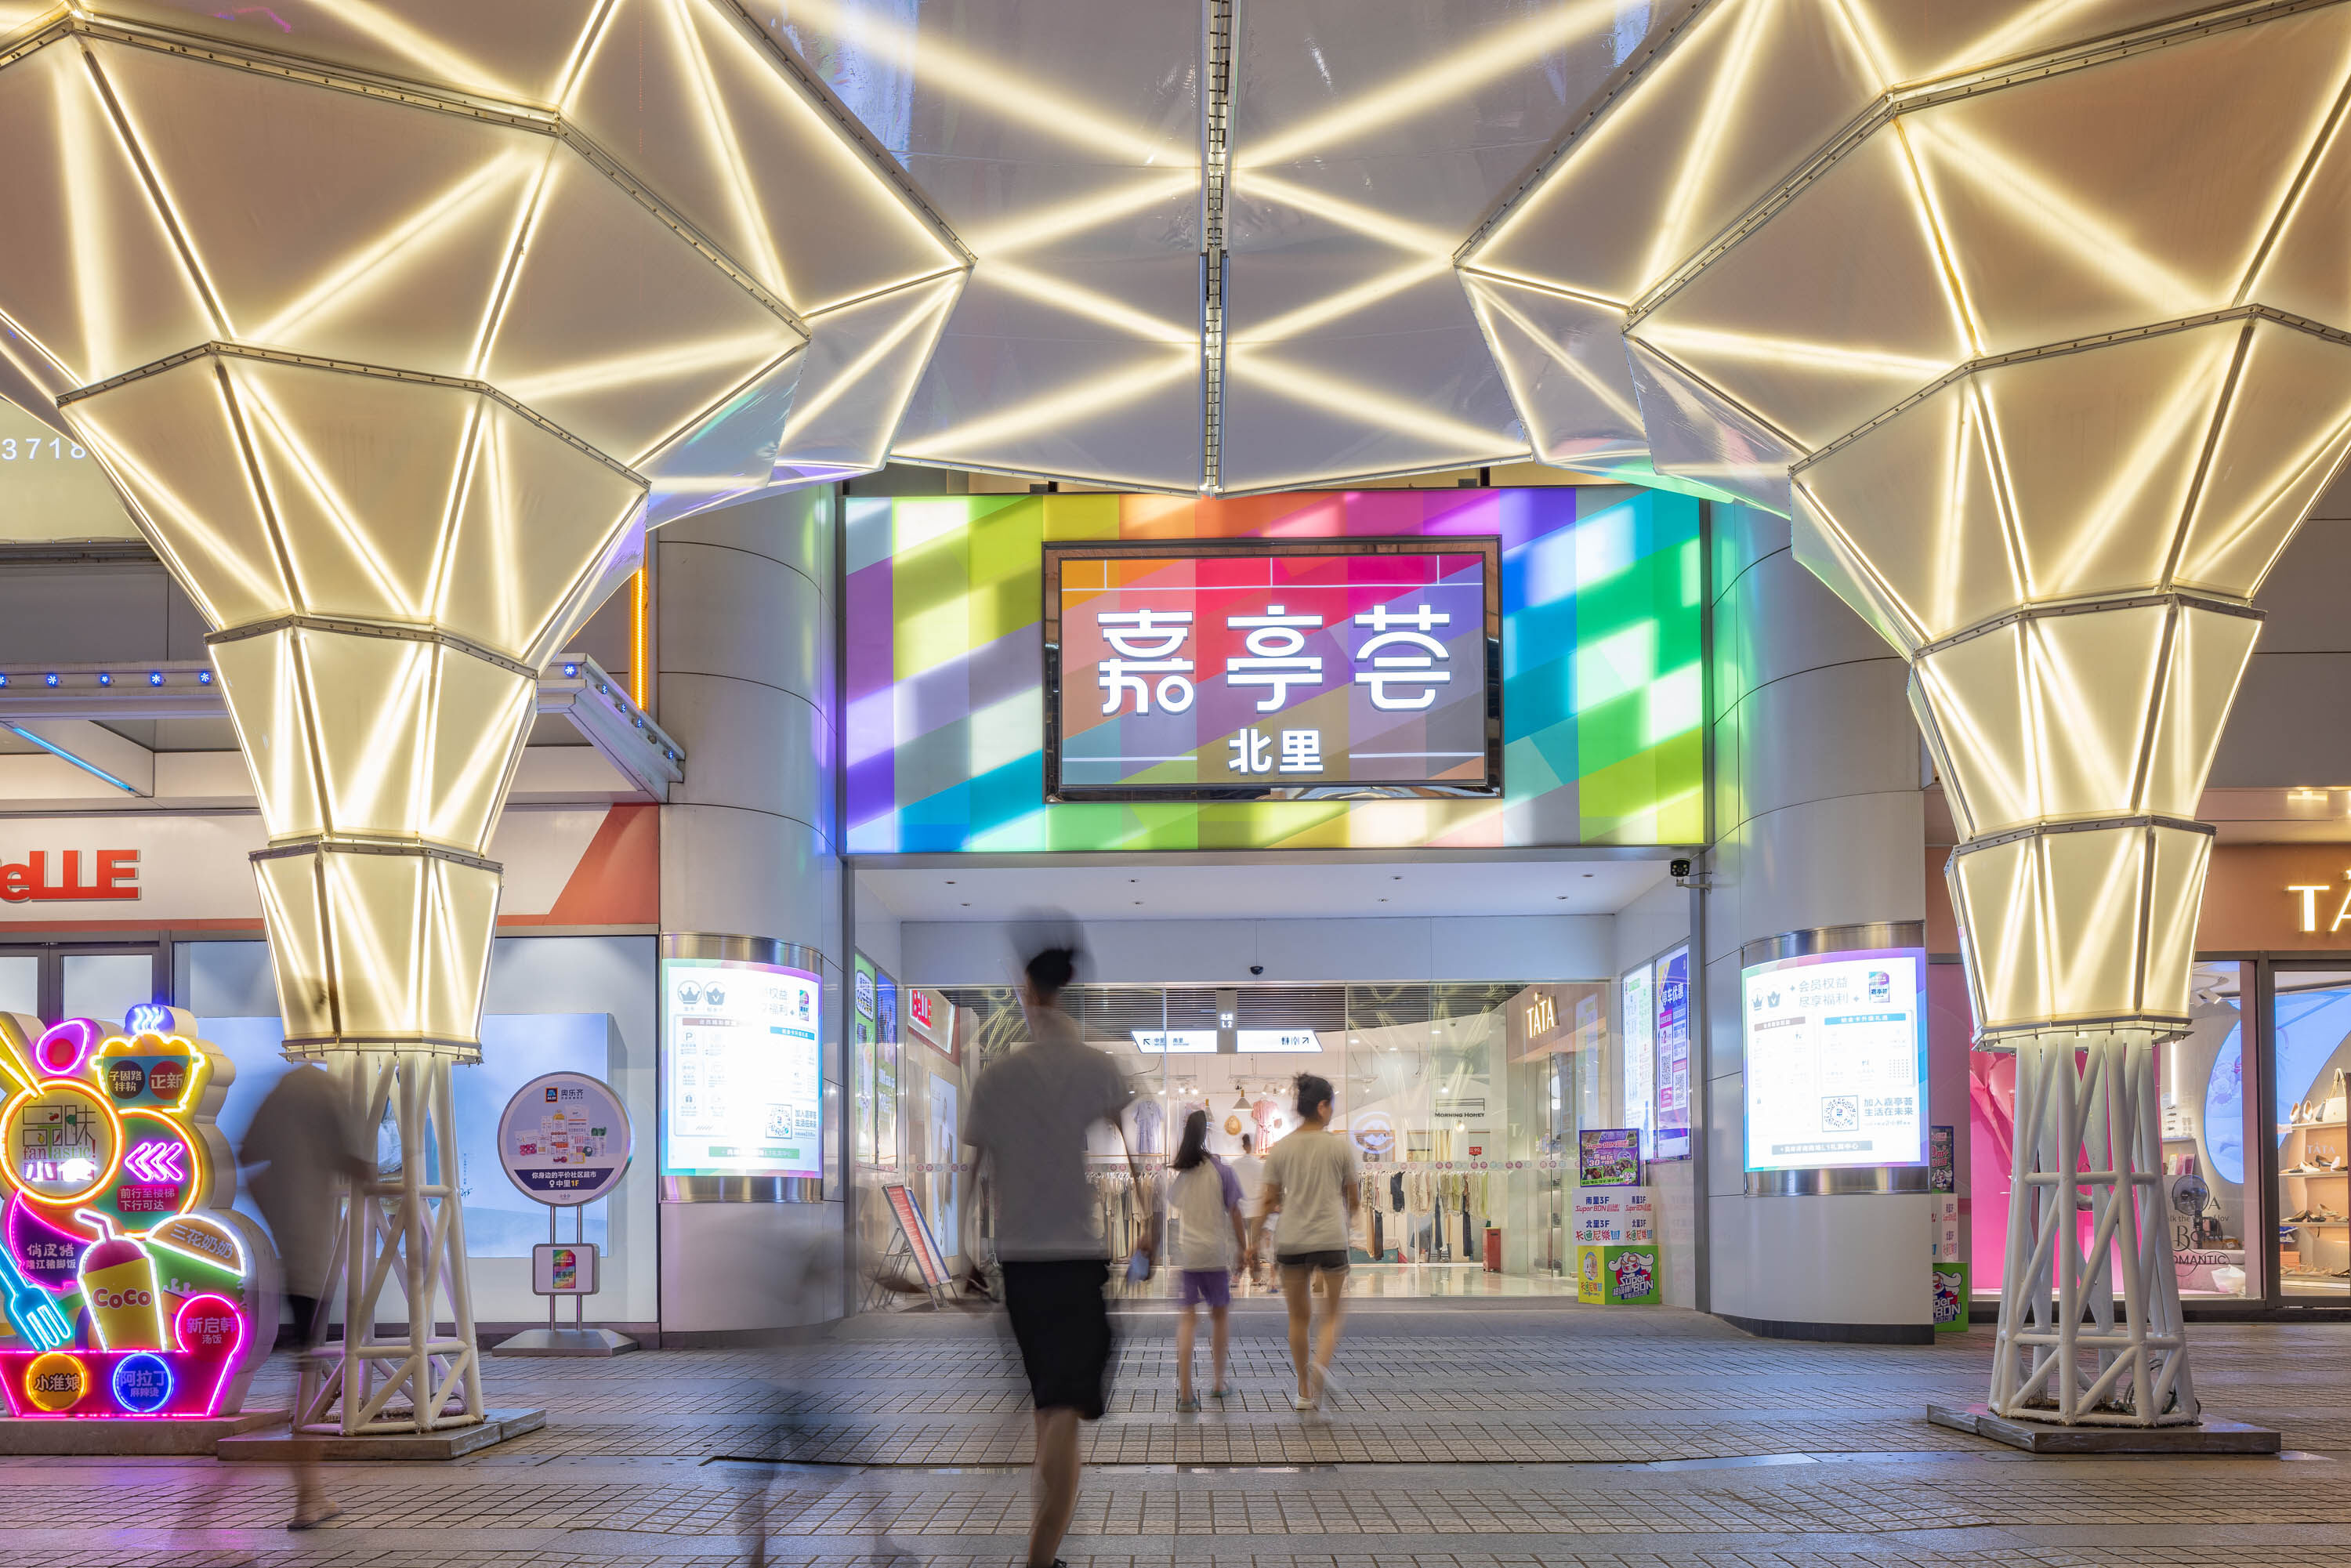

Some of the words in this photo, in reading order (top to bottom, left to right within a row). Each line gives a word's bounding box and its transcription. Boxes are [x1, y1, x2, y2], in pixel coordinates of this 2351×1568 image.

[1228, 728, 1324, 775] 北里
[110, 1070, 142, 1081] 子固路
[150, 1072, 183, 1089] 正新
[114, 1081, 136, 1092] 拌粉
[120, 1187, 175, 1199] 前行至楼梯
[120, 1199, 165, 1211] 下行可达
[1585, 1196, 1610, 1204] 南里3F
[1585, 1219, 1610, 1228] 北里3F
[170, 1222, 233, 1259] 三花奶奶
[201, 1334, 222, 1344] 汤饭
[120, 1371, 165, 1387] 阿拉丁
[129, 1387, 160, 1398] 麻辣烫
